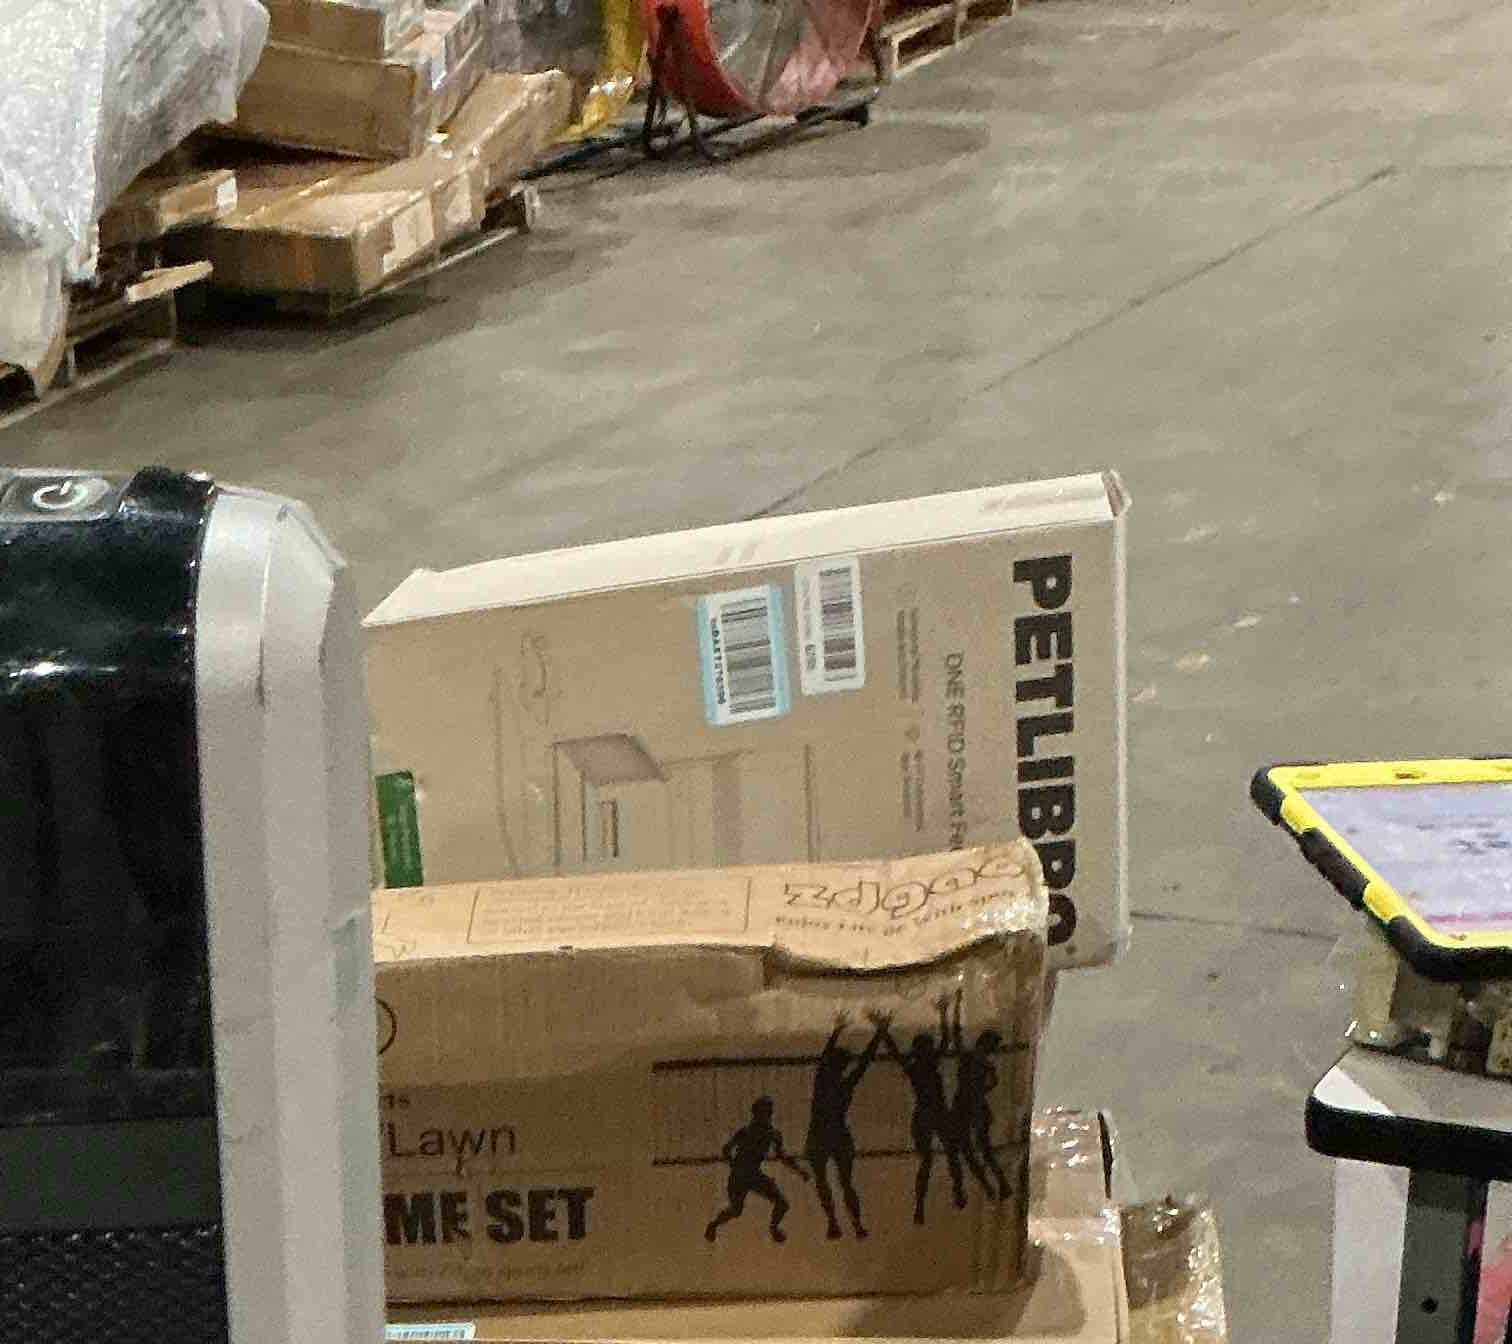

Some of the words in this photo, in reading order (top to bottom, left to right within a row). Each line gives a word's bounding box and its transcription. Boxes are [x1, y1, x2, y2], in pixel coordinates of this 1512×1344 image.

[945, 651, 963, 698] ONE
[947, 756, 966, 818] Smart
[485, 1186, 594, 1244] SET
